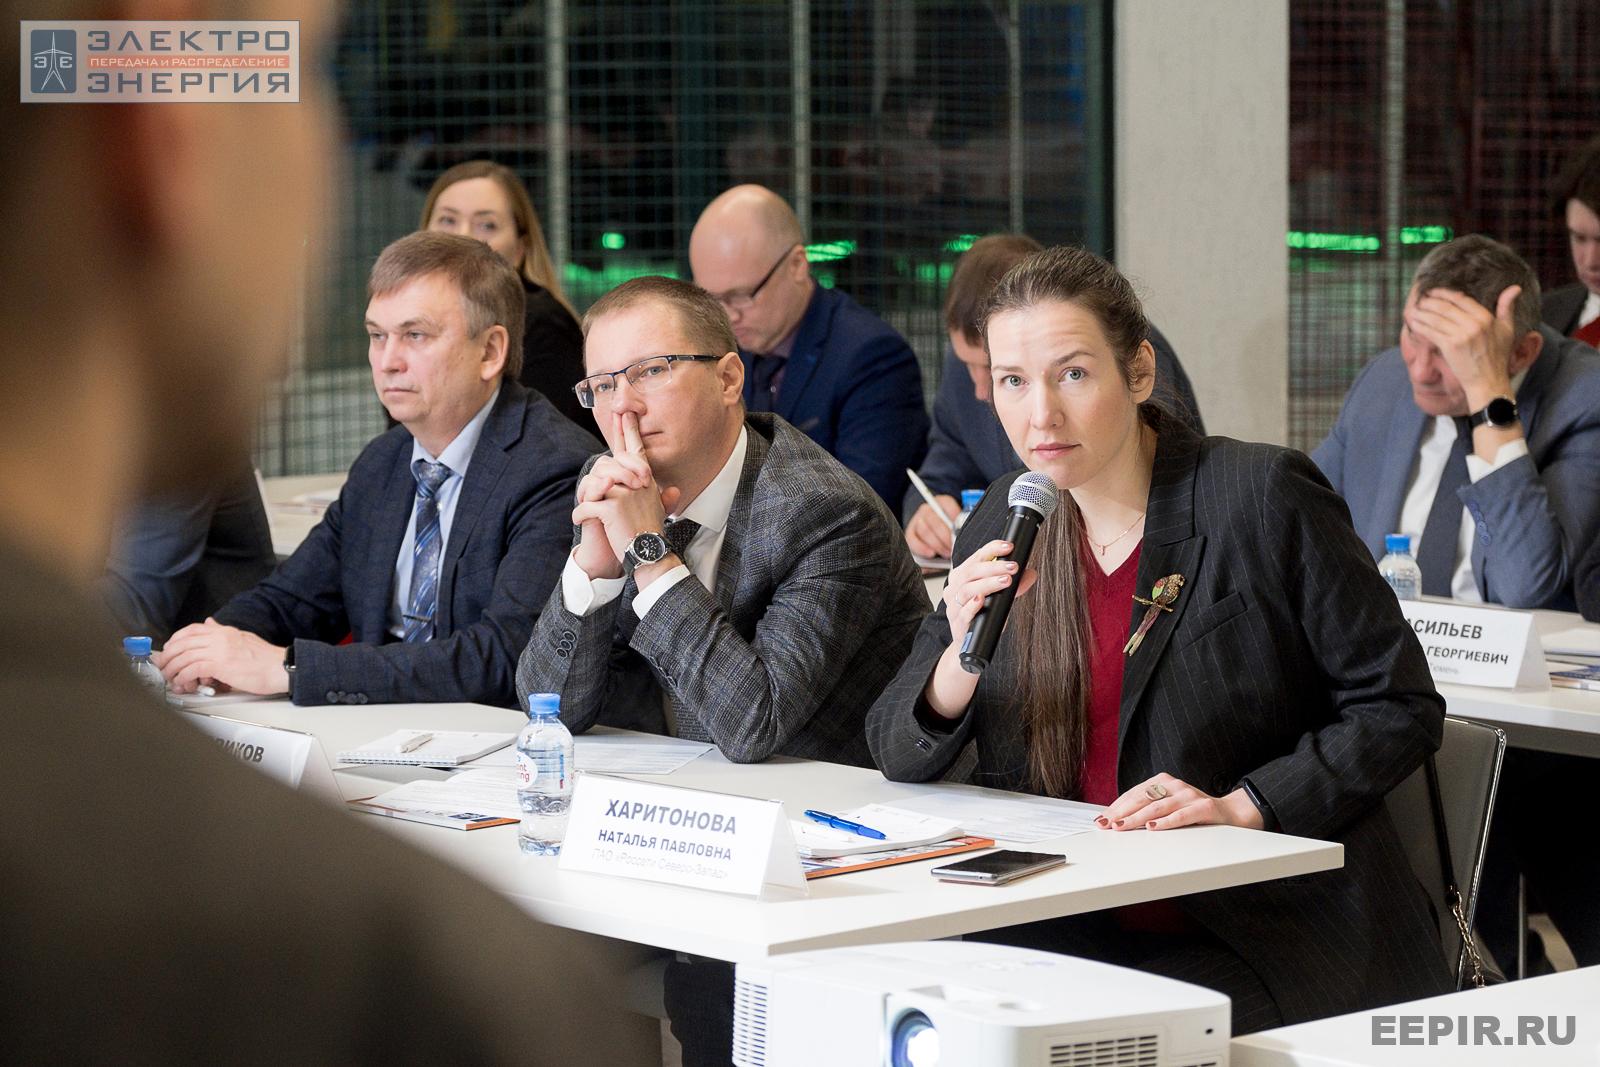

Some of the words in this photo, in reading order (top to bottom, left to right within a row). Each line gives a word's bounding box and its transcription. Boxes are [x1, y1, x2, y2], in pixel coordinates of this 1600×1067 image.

[1426, 645, 1509, 665] ГЕОРГИЕВИЧ
[605, 798, 736, 835] ХАРИТОНОВА
[598, 829, 657, 849] НАТАЛЬЯ
[660, 838, 732, 860] ПАВЛОВНА
